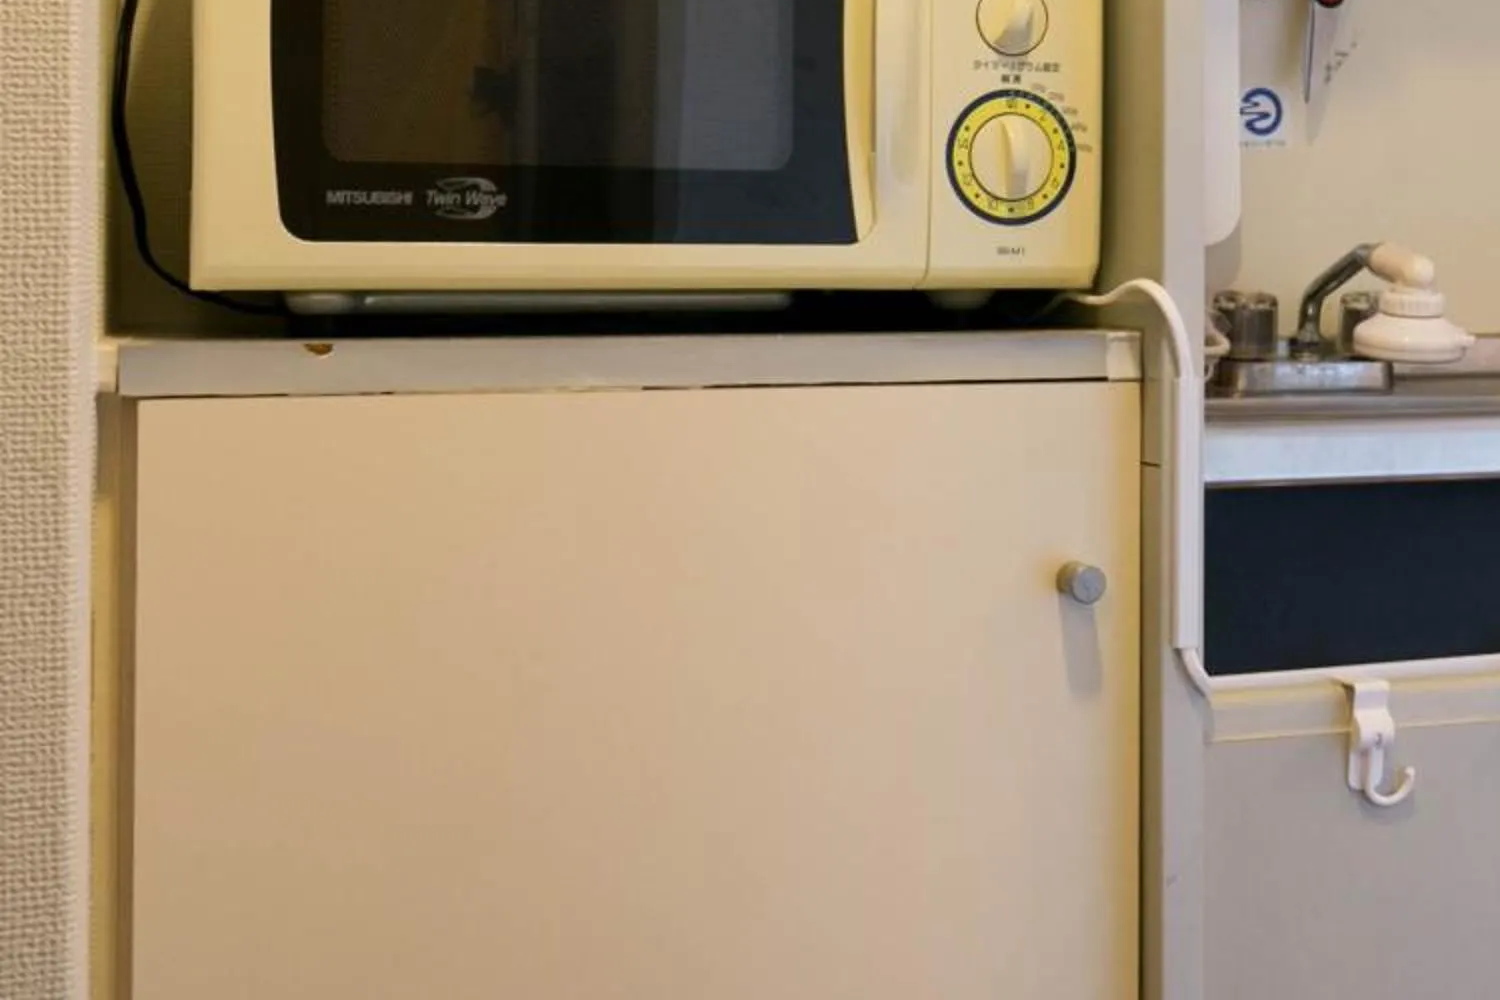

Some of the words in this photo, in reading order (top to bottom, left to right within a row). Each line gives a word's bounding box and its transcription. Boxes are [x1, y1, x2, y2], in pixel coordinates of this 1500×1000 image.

[325, 189, 414, 206] MITSUBISHI
[426, 189, 461, 207] Twin
[465, 189, 508, 207] Wave
